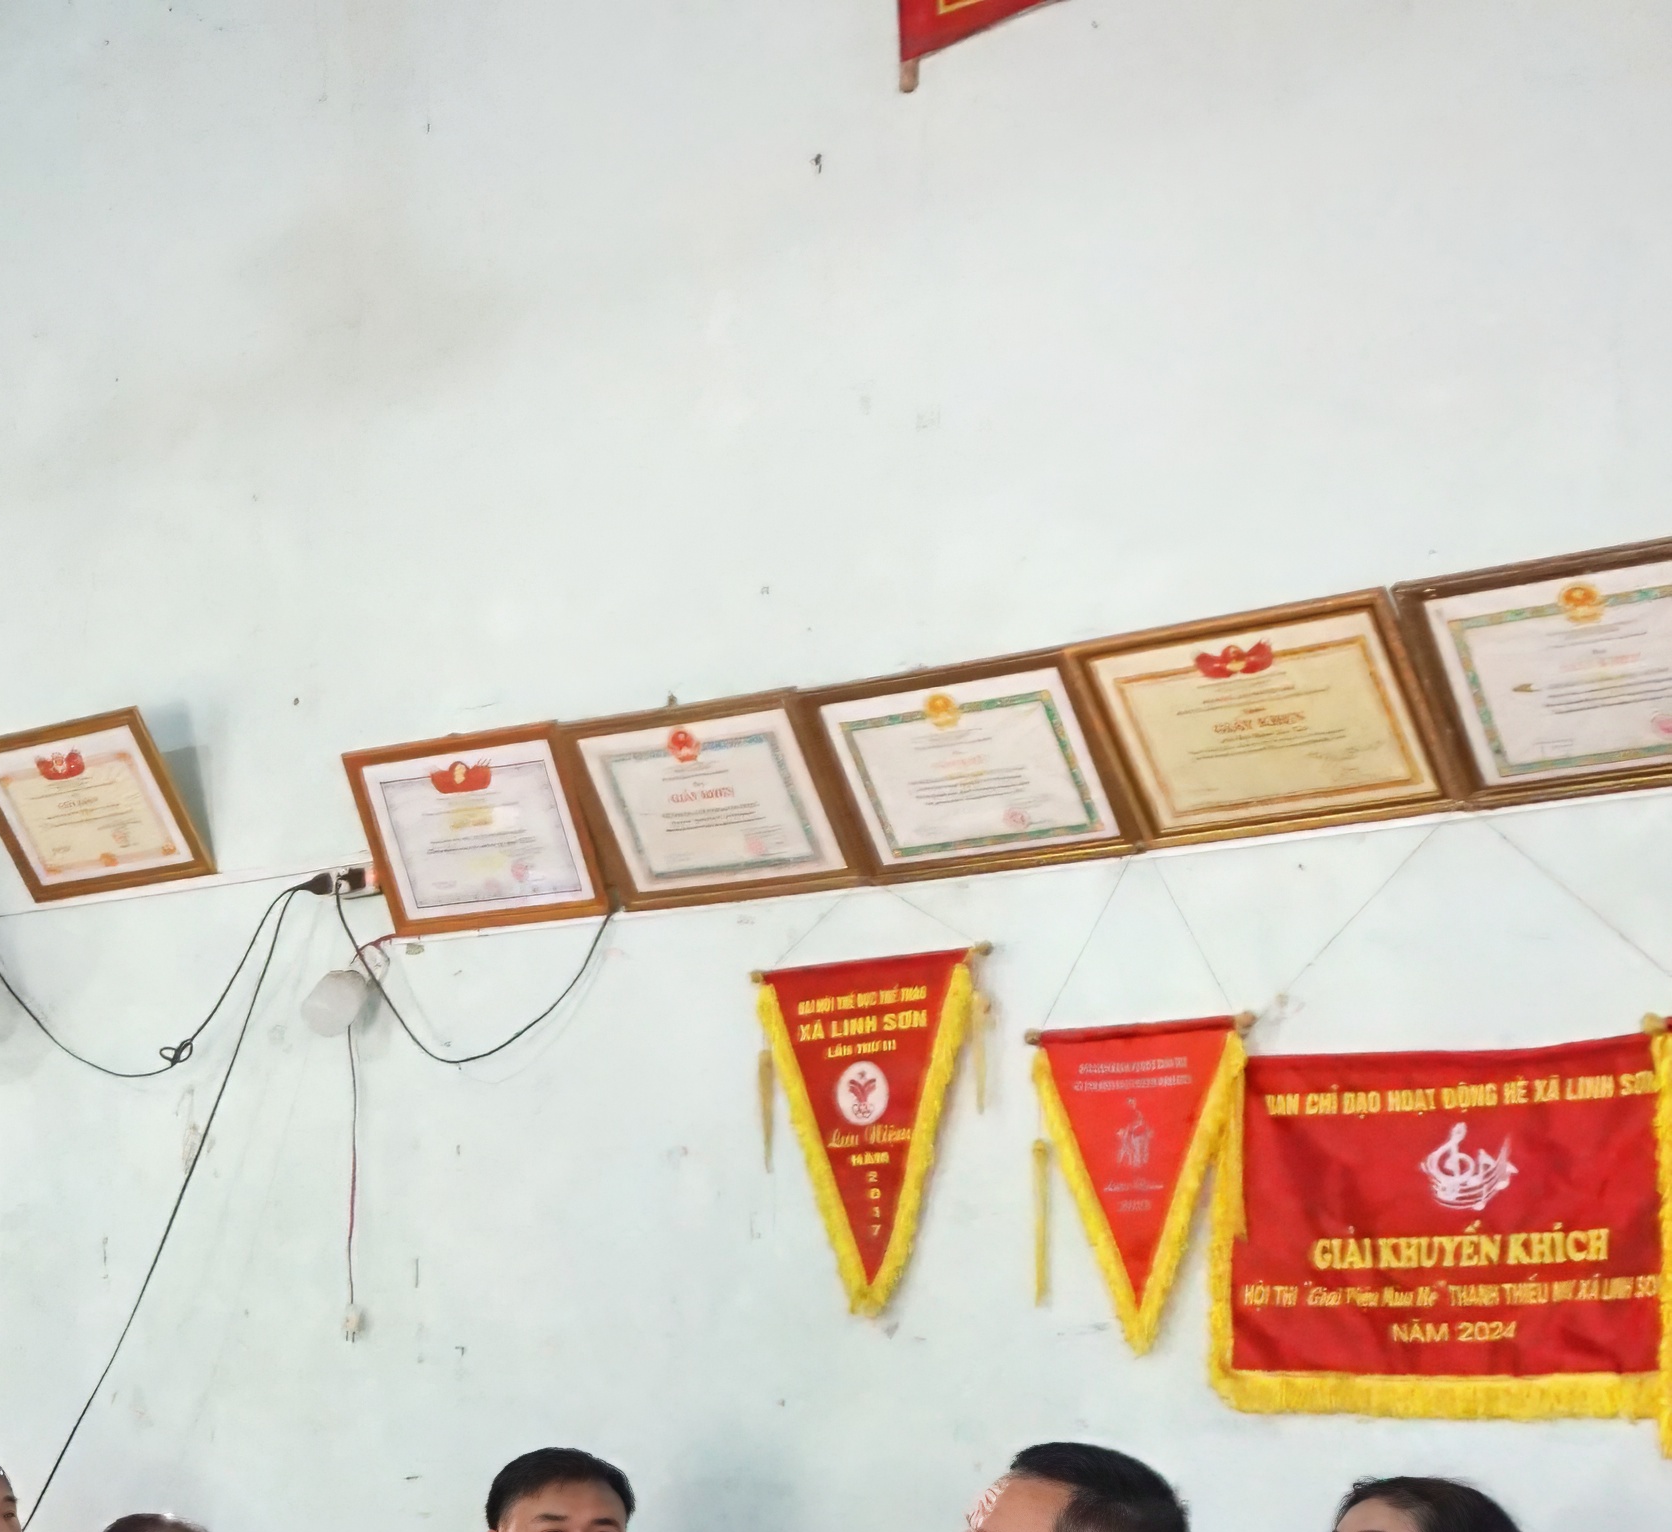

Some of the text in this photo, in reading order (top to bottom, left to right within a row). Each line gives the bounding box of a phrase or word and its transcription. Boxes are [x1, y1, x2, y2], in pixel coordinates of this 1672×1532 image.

[831, 1016, 877, 1038] LINH
[883, 1010, 927, 1031] SƠN
[1305, 1084, 1339, 1114] CHỈ
[1342, 1092, 1381, 1119] ĐẠO
[1387, 1088, 1435, 1116] HOẠT
[1443, 1082, 1497, 1113] ĐỘNG
[1534, 1076, 1560, 1102] XÃ
[1565, 1075, 1614, 1101] LINH
[1313, 1219, 1609, 1270] GIẢI KHUYẾN KHÍCH
[1244, 1280, 1270, 1311] HỘI
[1392, 1318, 1517, 1342] NĂM 2024
